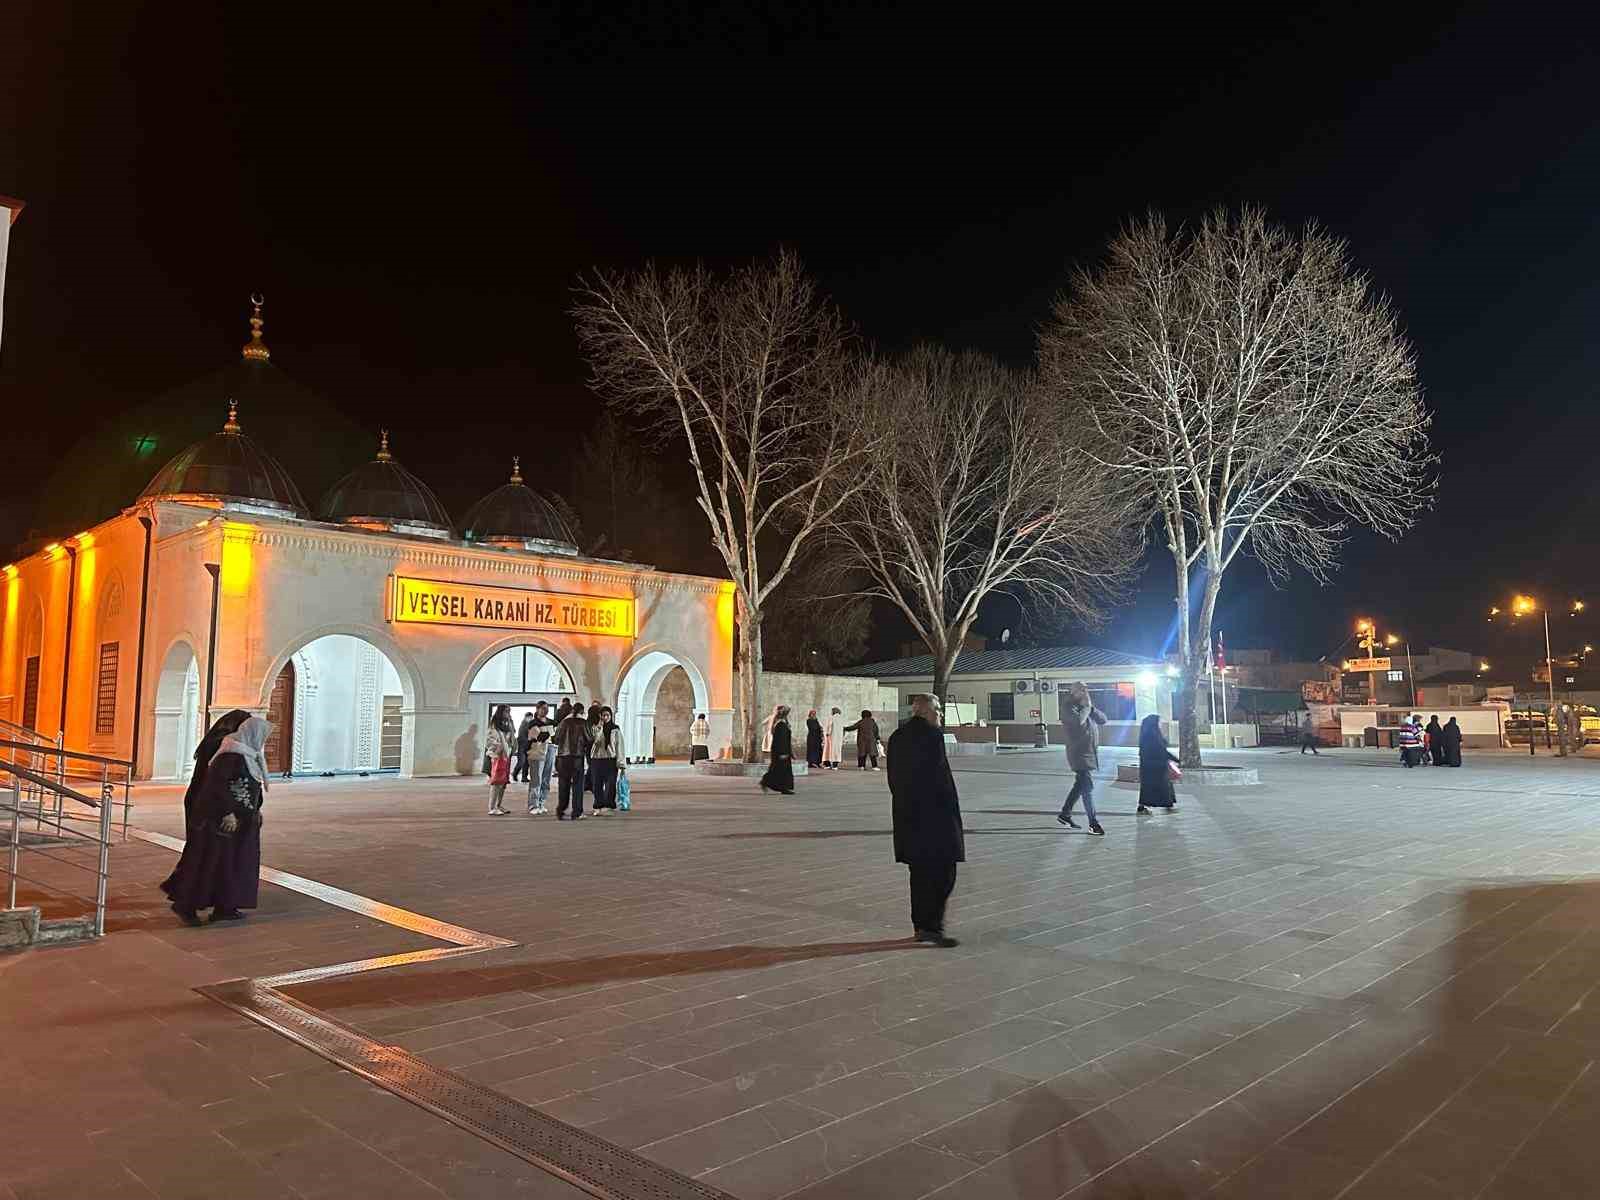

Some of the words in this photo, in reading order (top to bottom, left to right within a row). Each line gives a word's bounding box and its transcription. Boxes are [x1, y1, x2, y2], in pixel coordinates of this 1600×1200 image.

[409, 591, 468, 617] VEYSEL
[474, 597, 530, 622] KARANİ
[535, 607, 556, 625] HZ.
[562, 603, 616, 628] TÜRBESİ
